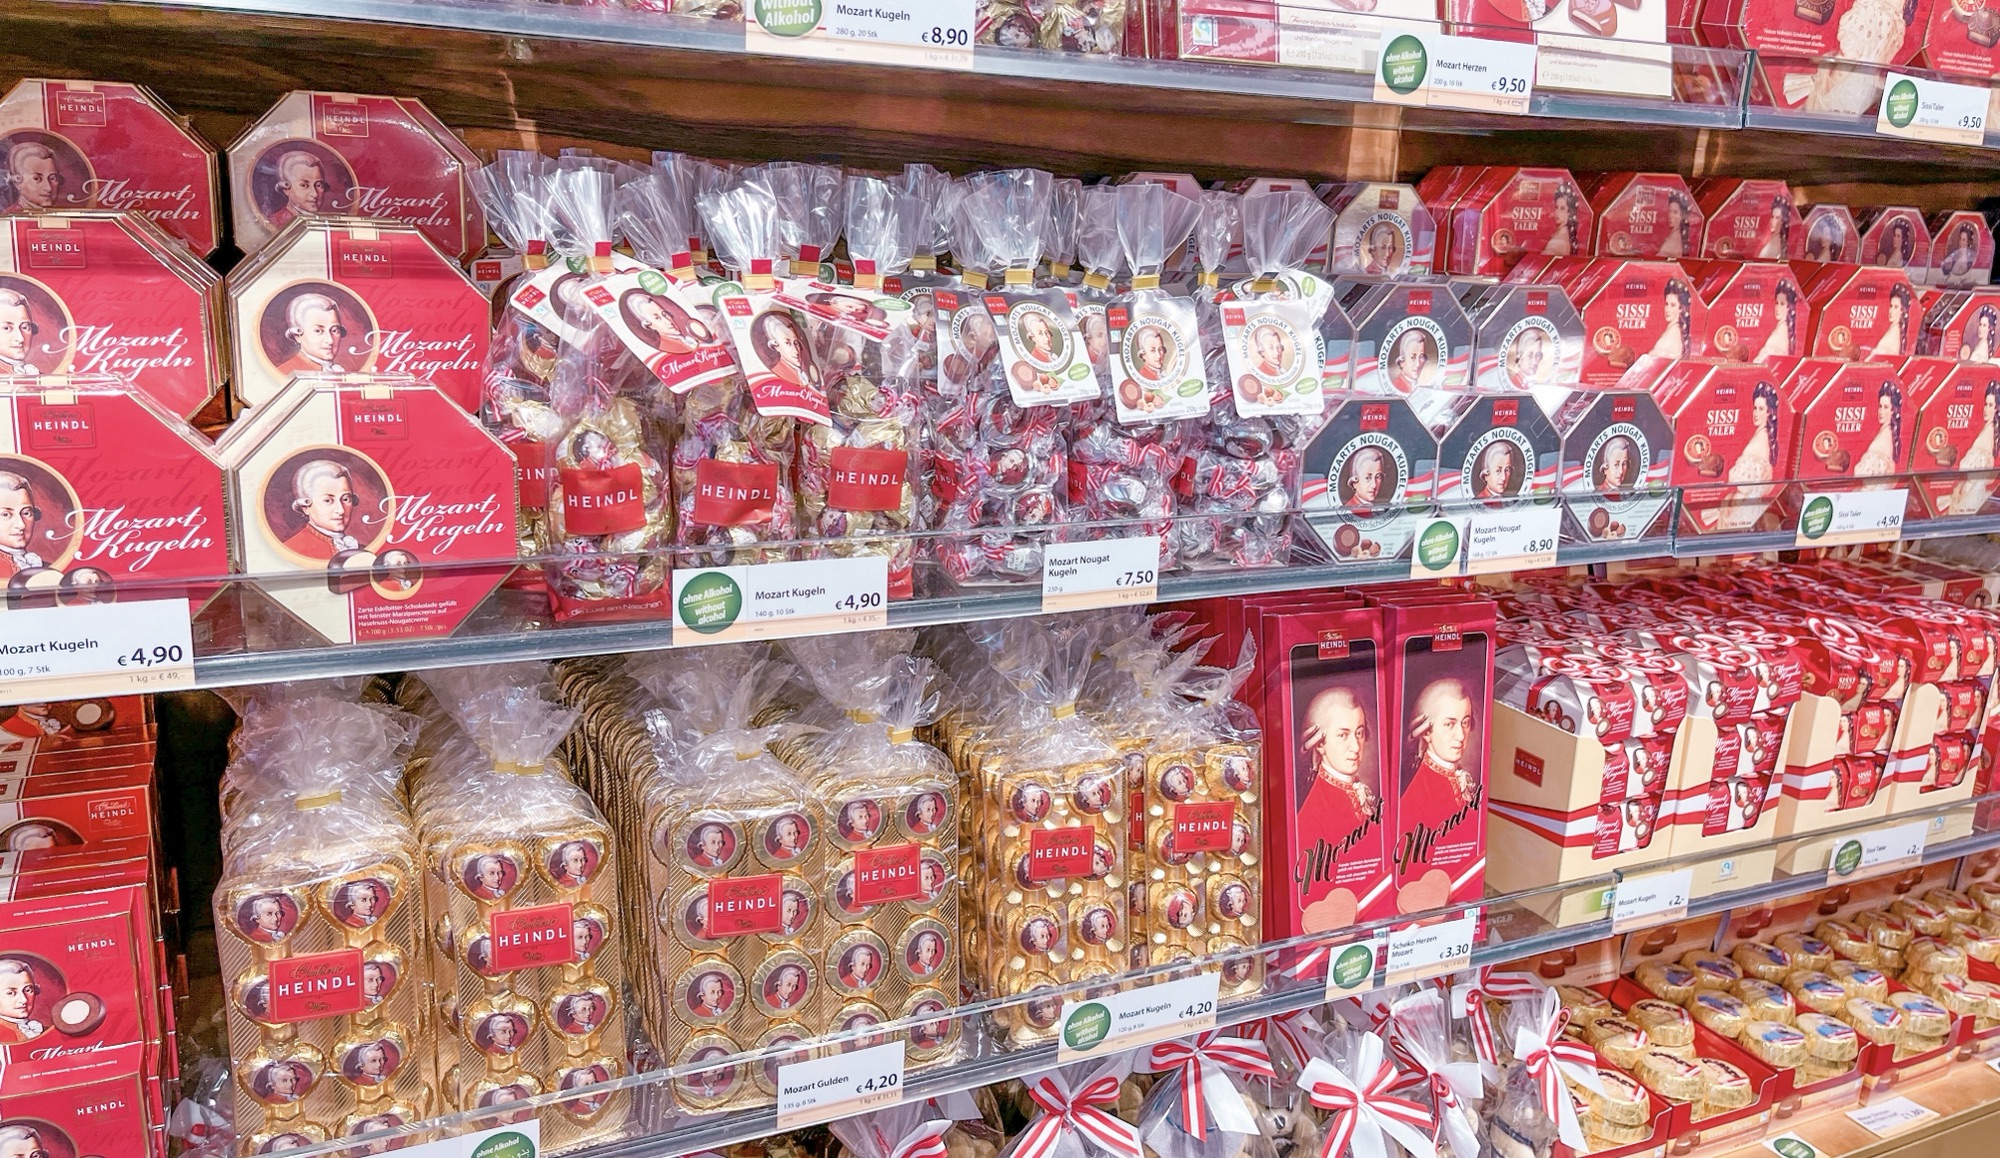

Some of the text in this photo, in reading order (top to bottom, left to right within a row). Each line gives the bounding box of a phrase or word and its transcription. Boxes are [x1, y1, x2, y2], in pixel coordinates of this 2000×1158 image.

[764, 10, 814, 28] Alkohol
[836, 4, 910, 22] Mozart Kugeln
[835, 28, 879, 38] 280 20 Stk
[932, 26, 968, 46] 8,90
[1436, 59, 1487, 73] Mozart Herzen
[1498, 76, 1526, 93] 9,50
[60, 104, 103, 112] HEINDL
[326, 114, 366, 124] HEINDL
[1962, 116, 1982, 128] 9,50
[66, 178, 196, 203] Mozart
[332, 186, 448, 209] Mozart
[1512, 206, 1543, 221] SISSI
[1628, 211, 1657, 224] SISSI
[1514, 222, 1538, 232] TALER
[1630, 224, 1654, 234] TALER
[1734, 216, 1760, 229] SISSI
[1354, 212, 1412, 259] MOZARTS NOUGAT KUGEL
[1734, 230, 1756, 239] TALER
[32, 244, 80, 252] HEINDL
[343, 252, 388, 262] HEINDL
[1616, 304, 1652, 318] SISSI
[1734, 303, 1764, 318] SISSI
[1850, 305, 1878, 318] SISSI
[1618, 320, 1646, 330] TALER
[1735, 319, 1760, 328] TALER
[1850, 320, 1874, 329] TALER
[42, 322, 190, 354] Mozart
[348, 328, 476, 356] Mozart
[1124, 317, 1185, 364] MOZARTS NOUGAT KUGEL
[1380, 318, 1446, 370] MOZARTS NOUGAT KUGEL
[1500, 318, 1555, 368] MOZARTS NOUGAT
[68, 345, 196, 382] Kugeln
[371, 351, 481, 380] Kugeln
[661, 355, 700, 379] Mozart
[756, 385, 804, 398] Mozart
[354, 414, 403, 423] HEINDL
[1706, 408, 1740, 425] SISSI
[1834, 406, 1866, 421] SISSI
[1946, 404, 1974, 418] SISSI
[34, 422, 90, 430] HEINDL
[1708, 426, 1736, 436] TALER
[1836, 423, 1862, 433] TALER
[1946, 420, 1969, 430] TALER
[1462, 429, 1534, 484] MOZARTS NOUGAT KUGEL
[1585, 424, 1649, 478] MOZARTS NOUGAT KUGEL
[1329, 434, 1407, 492] MOZARTS NOUGAT KUGEL
[836, 471, 899, 486] HEINDL
[568, 488, 639, 508] HEINDL
[702, 484, 772, 500] HEINDL
[362, 492, 500, 524] Mozart
[46, 504, 208, 542] Mozart
[1880, 516, 1900, 526] 4,90
[386, 511, 506, 555] Kugeln
[1474, 524, 1522, 534] Mozart Nougat
[1473, 536, 1496, 546] Kugeln
[1529, 538, 1553, 554] 8,90
[73, 525, 214, 573] Kugeln
[1048, 554, 1110, 567] Mozart Nougat
[1048, 568, 1078, 578] Kugeln
[1124, 570, 1154, 586] 7,50
[683, 584, 733, 605] ohne Alkohol
[755, 586, 826, 600] Mozart Kugeln
[622, 600, 663, 611] Naschen
[694, 600, 726, 617] without
[844, 592, 881, 610] 4,90
[358, 606, 373, 614] Zarte
[368, 611, 392, 620] feinster
[698, 610, 726, 626] alcohol
[1320, 640, 1348, 649] HEINDL
[1434, 632, 1462, 642] HEINDL
[0, 638, 98, 656] Mozart Kugeln
[130, 644, 184, 668] 4,90
[36, 664, 51, 674] Stk
[1773, 661, 1800, 676] Mozart
[1660, 687, 1685, 700] Mozart
[1603, 700, 1632, 712] Mozart
[1514, 758, 1542, 776] HEINDL
[91, 808, 135, 819] HEINDL
[1178, 820, 1228, 832] HEINDL
[1392, 784, 1483, 876] Mozart
[1035, 845, 1088, 860] HEINDL
[1294, 797, 1384, 896] Mozart
[860, 865, 916, 882] HEINDL
[715, 897, 776, 912] HEINDL
[1618, 894, 1656, 906] Mozart Kugeln
[499, 927, 568, 948] HEINDL
[1392, 936, 1438, 950] Schoko Herzen
[68, 939, 116, 952] HEINDL
[1391, 948, 1414, 958] Mozart
[1445, 943, 1469, 958] 3,30
[278, 974, 356, 996] HEINDL
[1118, 1002, 1172, 1020] Mozart Kugeln
[1184, 1000, 1212, 1017] 4,20
[1068, 1010, 1105, 1031] ohne Alkohol
[1076, 1024, 1099, 1038] without
[1077, 1030, 1098, 1045] alcohol
[784, 1076, 850, 1096] Mozart Gulden
[864, 1073, 898, 1092] 4,20
[76, 1100, 126, 1116] HEINDL
[476, 1148, 494, 1158] ohne
[494, 1136, 520, 1152] Alkohol
